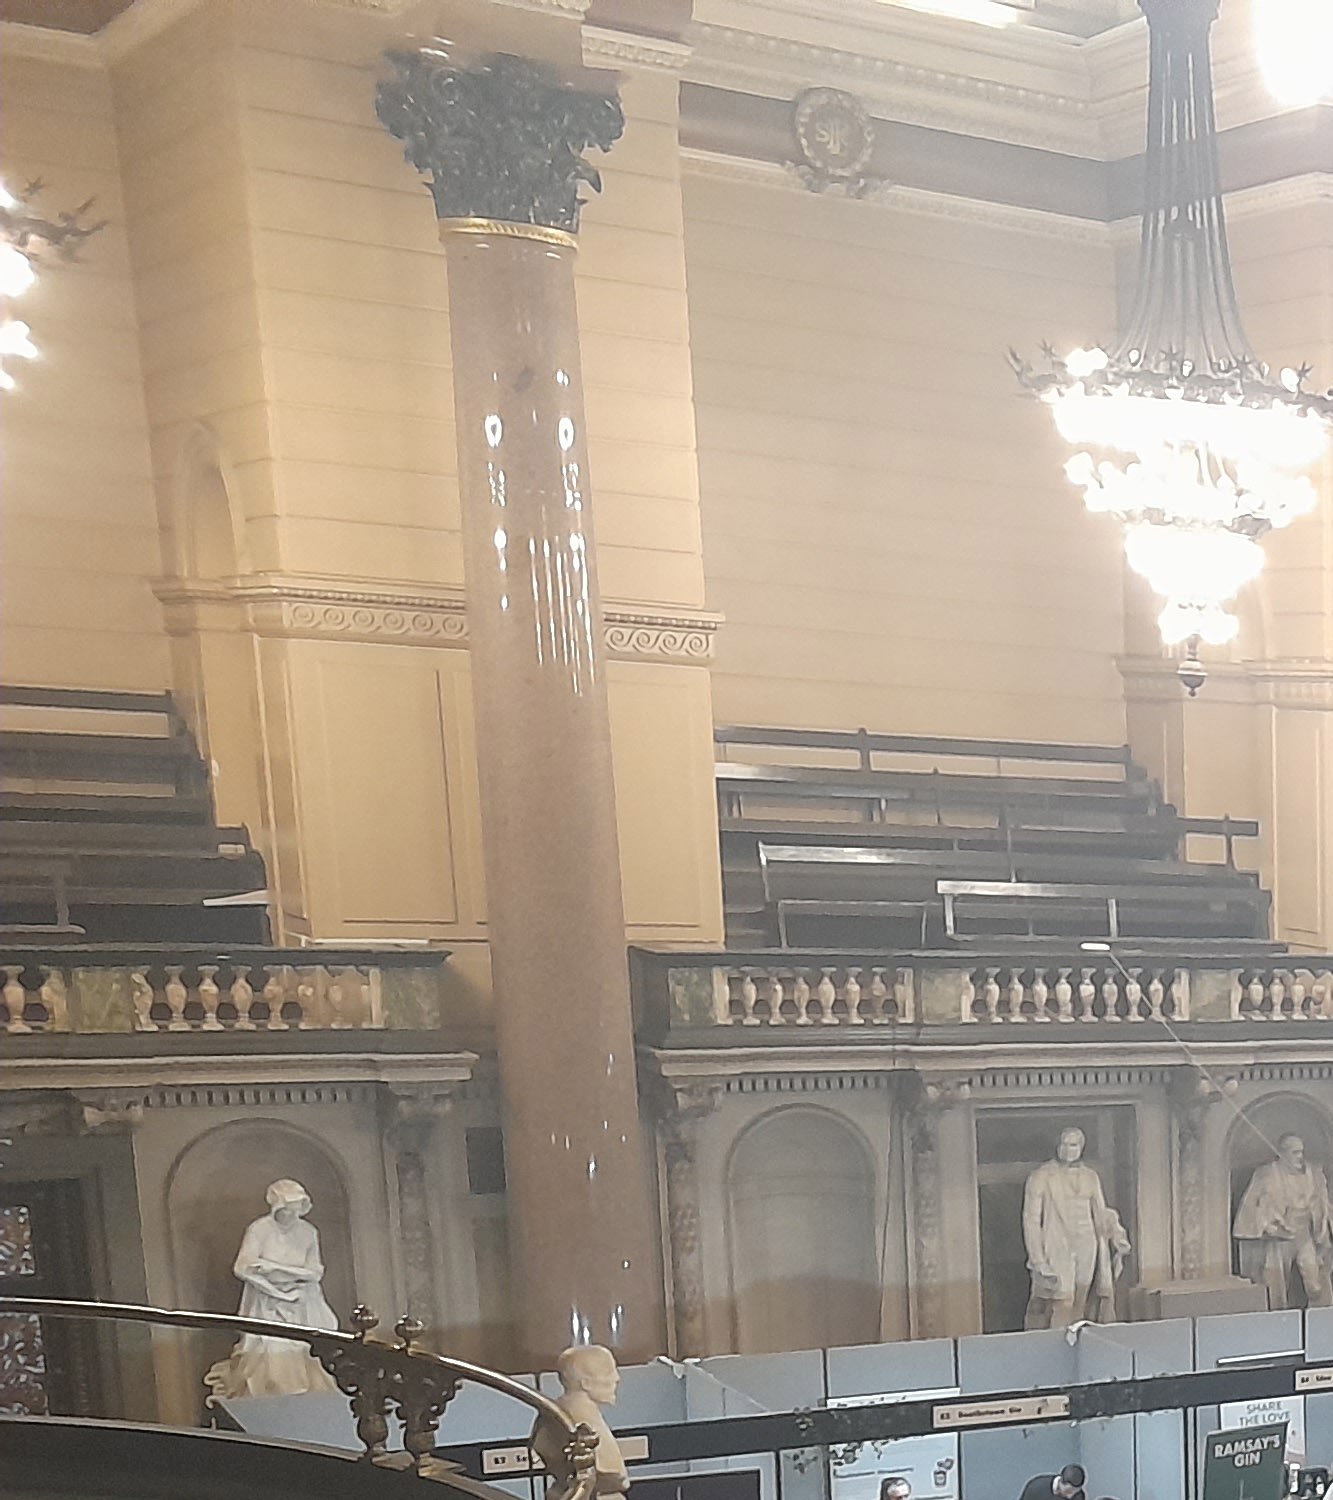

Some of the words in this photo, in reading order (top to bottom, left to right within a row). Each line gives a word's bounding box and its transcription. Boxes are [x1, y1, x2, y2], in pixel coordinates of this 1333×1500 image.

[1246, 1401, 1283, 1414] SHARE
[1239, 1414, 1260, 1427] THE
[1262, 1411, 1290, 1424] LOVE
[1214, 1434, 1281, 1459] RAMSAY'S
[1234, 1451, 1261, 1467] GIN
